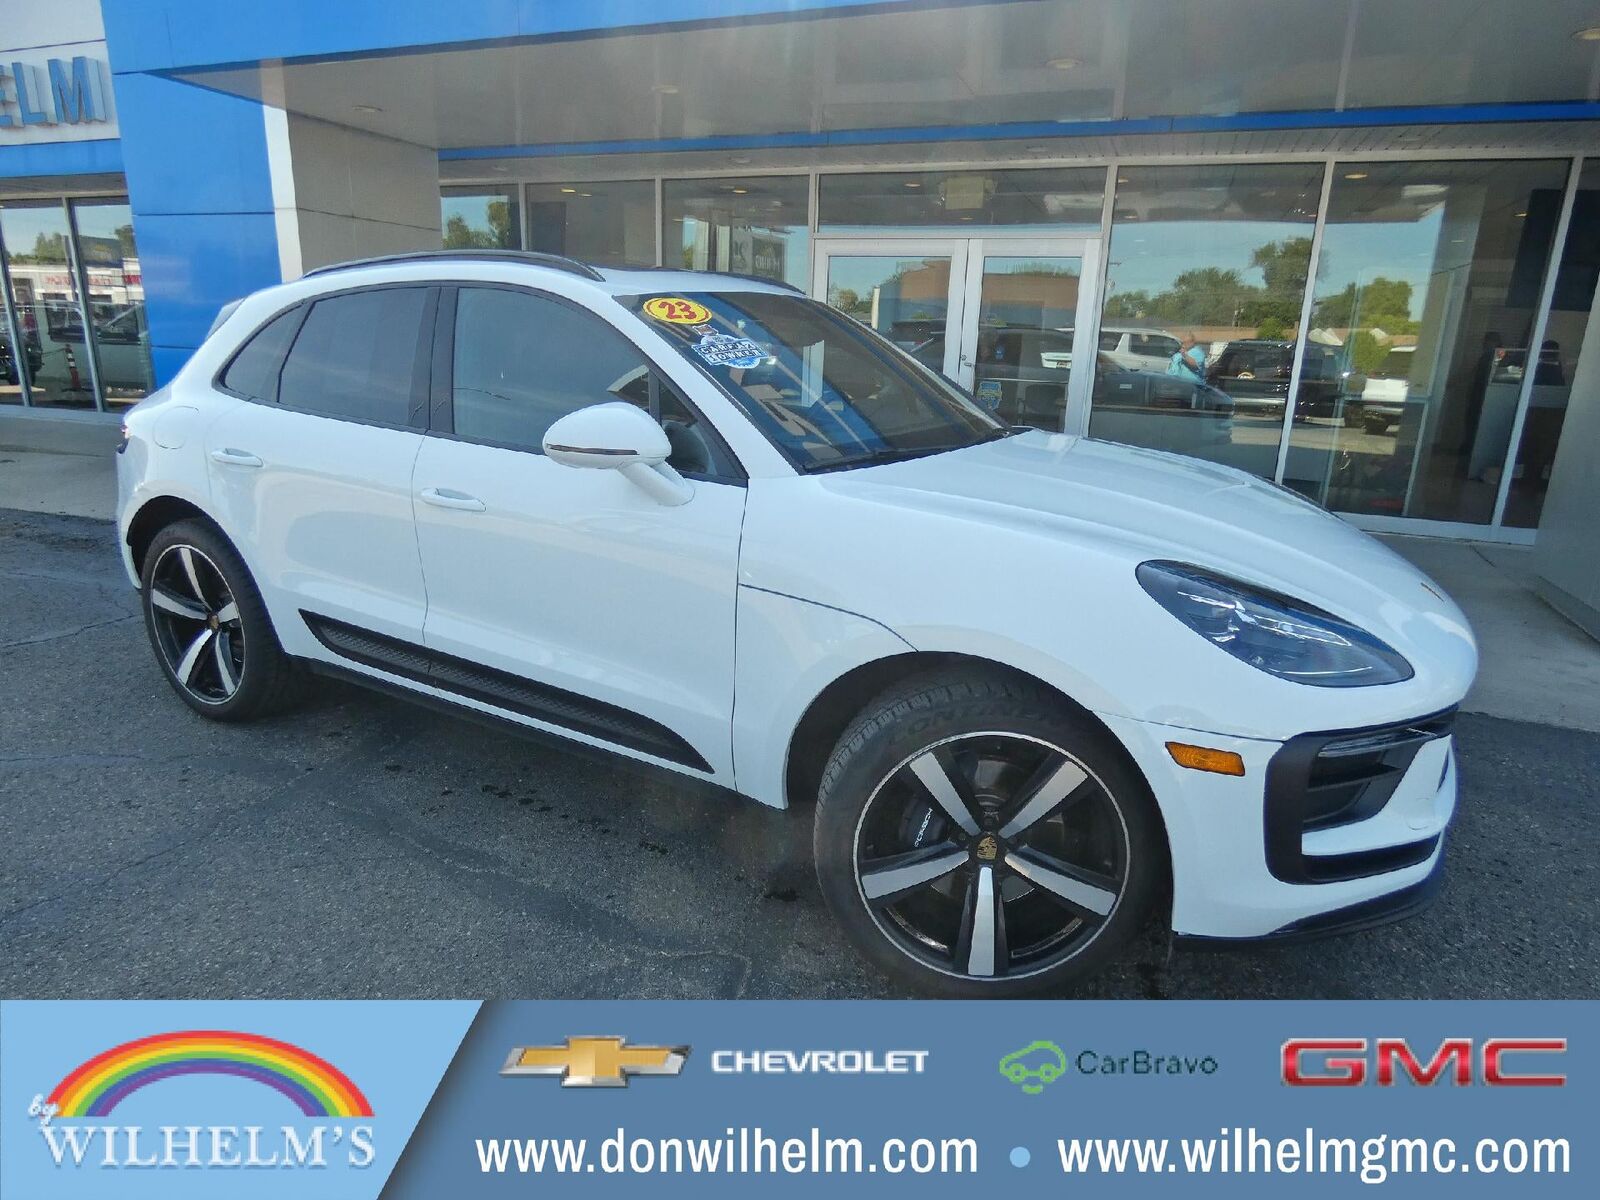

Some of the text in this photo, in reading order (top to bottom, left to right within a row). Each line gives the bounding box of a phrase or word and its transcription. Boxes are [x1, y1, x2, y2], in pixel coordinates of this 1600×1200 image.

[658, 301, 697, 320] 23
[700, 341, 755, 354] CARFAX
[717, 349, 762, 361] OWNER
[914, 808, 931, 847] PORSCH
